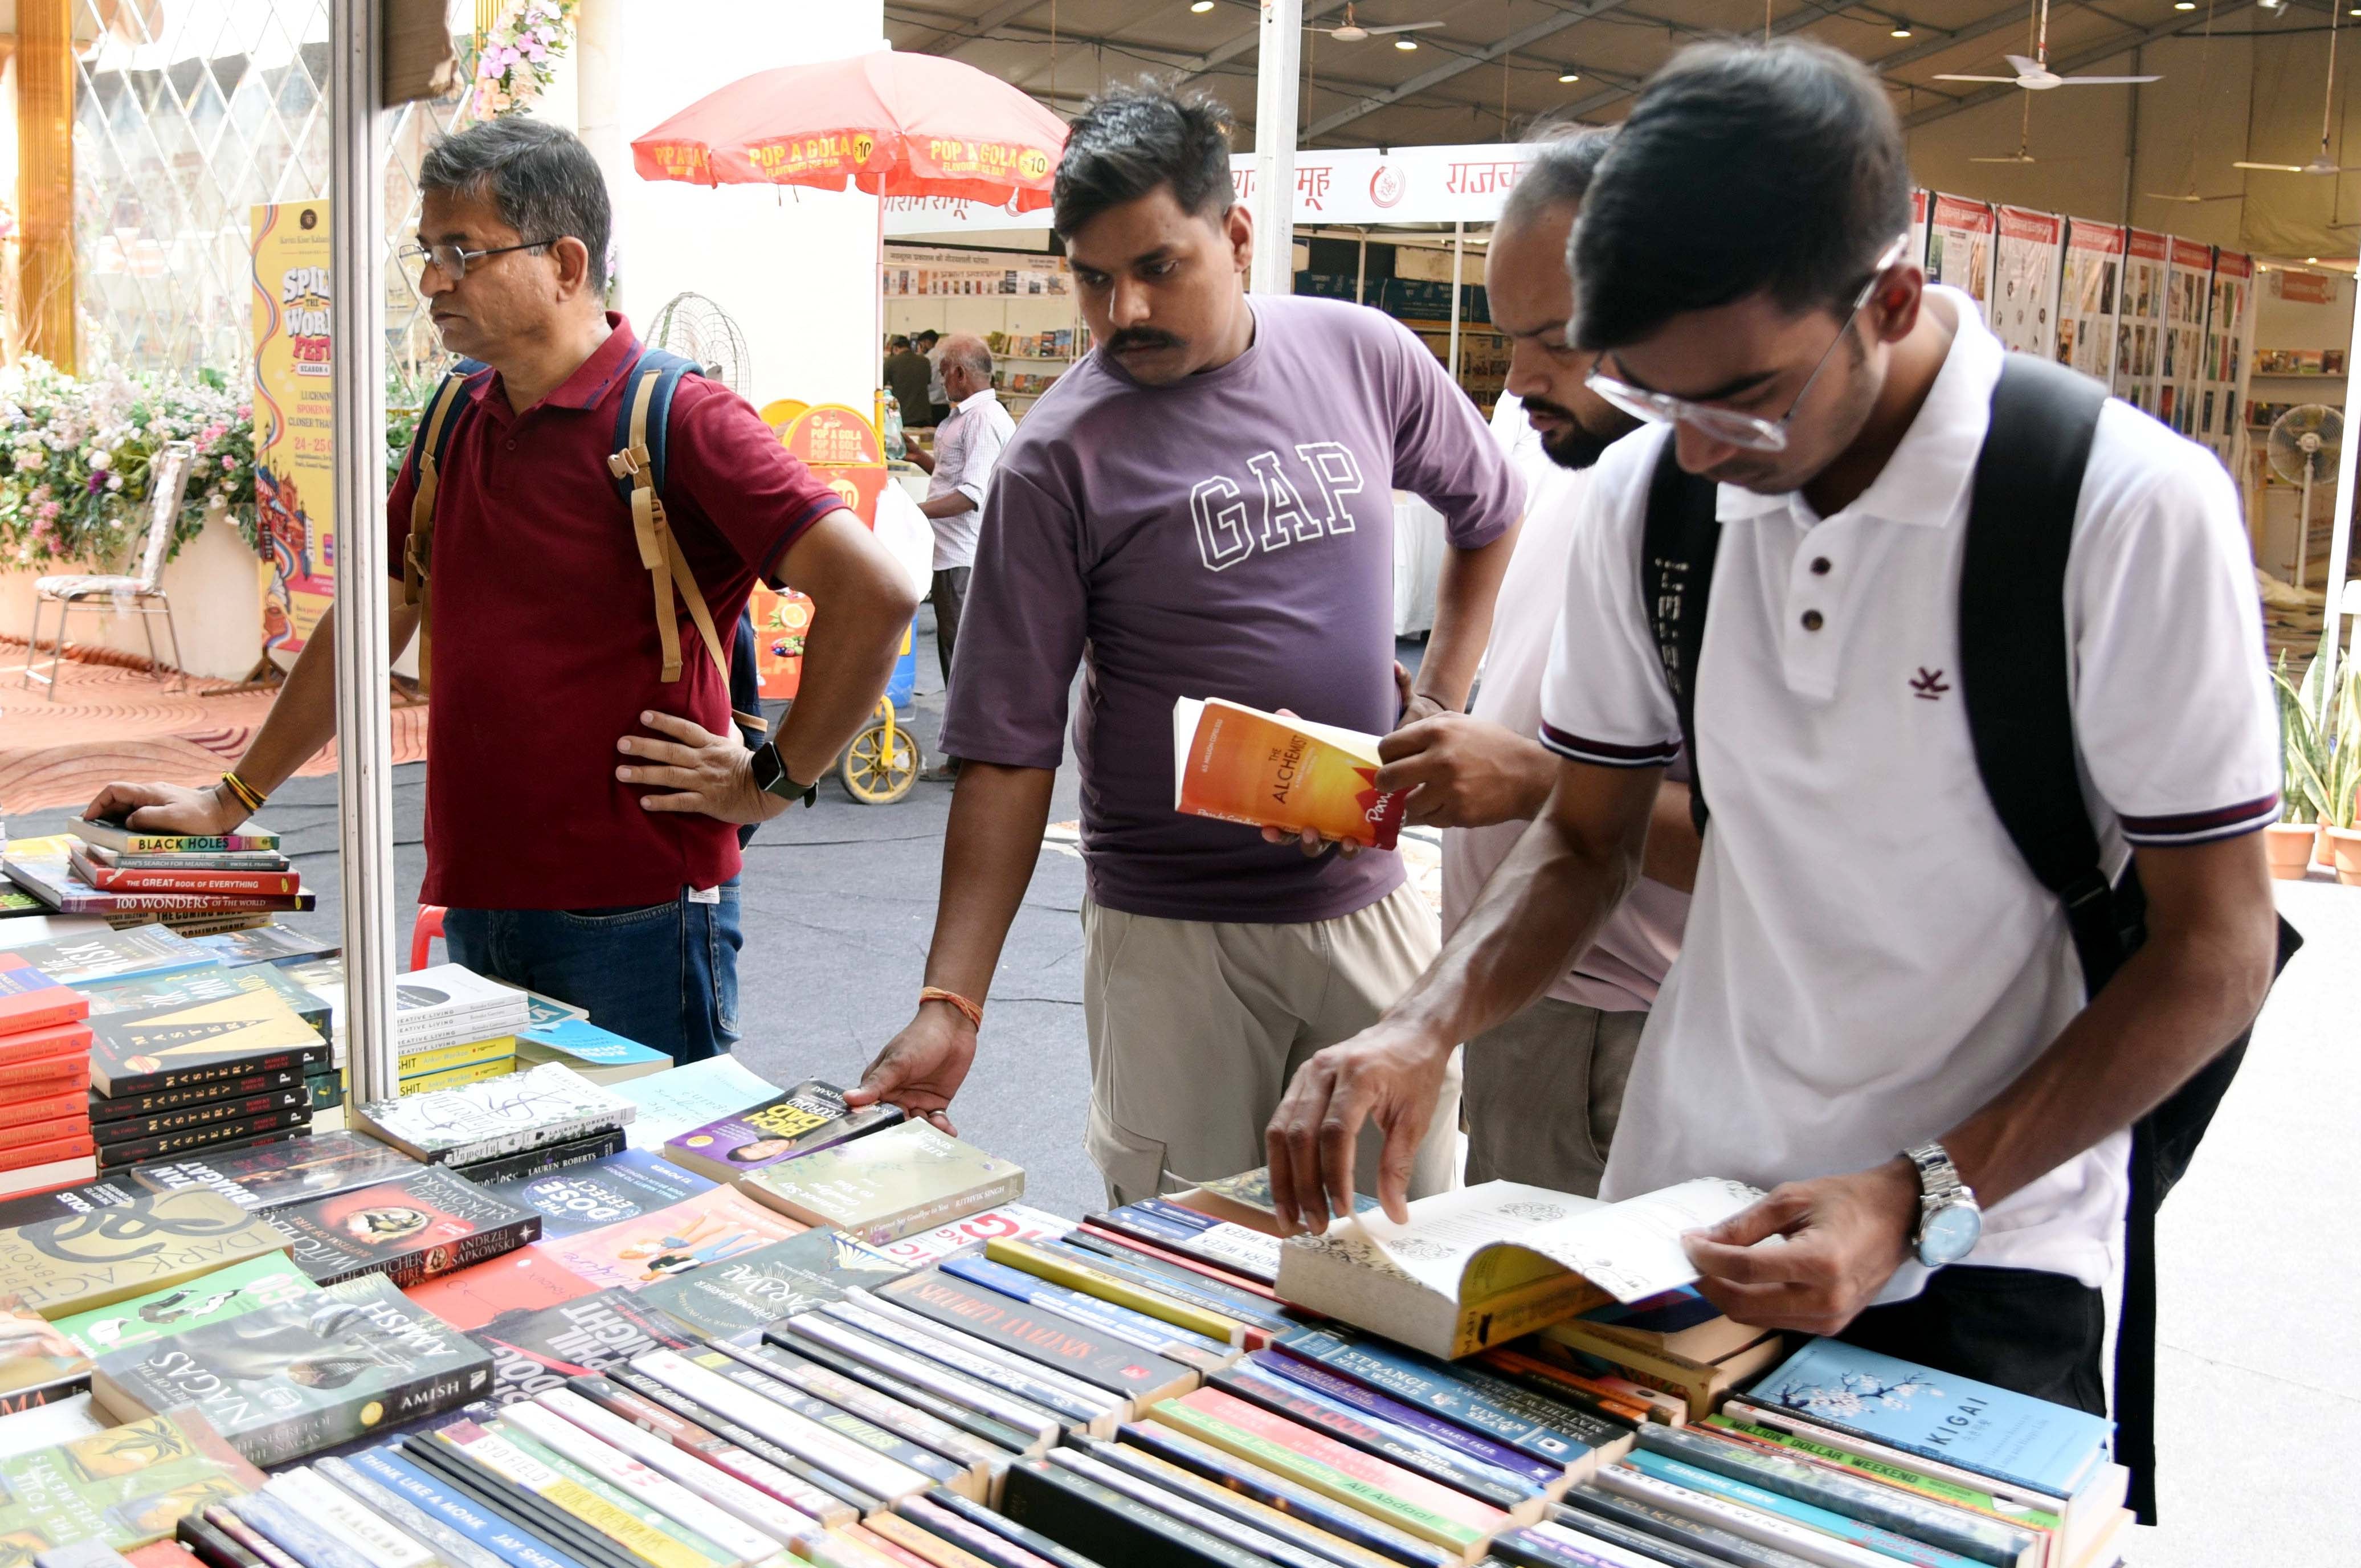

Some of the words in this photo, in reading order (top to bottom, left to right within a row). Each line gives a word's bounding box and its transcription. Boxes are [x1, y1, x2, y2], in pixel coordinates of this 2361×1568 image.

[749, 145, 785, 168] POP
[791, 142, 802, 162] A
[806, 136, 852, 160] GOLA
[930, 140, 962, 161] POP
[967, 142, 979, 162] A
[980, 144, 1017, 168] GOLA
[1295, 166, 1332, 211] मूह
[305, 298, 319, 307] THE
[288, 417, 313, 428] CLOSER
[296, 404, 324, 415] SPOKEN
[295, 436, 307, 450] 24
[811, 428, 828, 439] POP
[830, 429, 838, 439] A
[839, 429, 861, 440] GOLA
[811, 439, 828, 449] POP
[830, 439, 838, 450] A
[839, 439, 861, 451] GOLA
[1190, 441, 1364, 572] GAP
[1204, 738, 1215, 765] MILLION
[1268, 746, 1282, 762] THE
[1272, 734, 1310, 805] ALCHEMIST
[138, 838, 183, 850] BLACK
[187, 837, 229, 849] HOLES
[144, 859, 169, 868] SEARCH
[142, 877, 174, 888] GREAT
[175, 880, 196, 888] BOOK
[209, 880, 259, 889] EVERYTHING
[115, 897, 137, 910] 100
[141, 897, 209, 910] WONDERS
[156, 912, 174, 922] THE
[56, 941, 135, 974] RISK
[429, 1009, 455, 1018] LIVING
[430, 1019, 454, 1028] LIVING
[131, 1019, 257, 1046] MASTERY
[431, 1030, 455, 1040] LIVING
[431, 1040, 456, 1050] LIVING
[165, 1063, 255, 1088] MASTERY
[400, 1083, 421, 1097] SHIT
[142, 1085, 231, 1110] MASTERY
[149, 1106, 236, 1131] MASTERY
[549, 1122, 578, 1136] LAUREN
[581, 1114, 615, 1128] ROBERTS
[742, 1110, 800, 1139] RICH
[766, 1102, 832, 1130] DAD
[808, 1104, 844, 1121] POOR
[158, 1126, 244, 1152] MASTERY
[149, 1166, 185, 1190] TAN
[528, 1161, 559, 1177] LAUREN
[562, 1152, 597, 1167] ROBERTS
[650, 1162, 684, 1182] POWER
[175, 1162, 258, 1210] BHAGAT
[413, 1174, 507, 1220] SAPKOWSKI
[533, 1179, 612, 1220] DOSE
[569, 1179, 634, 1213] EFFECT
[405, 1186, 475, 1221] ANDRZEJ
[533, 1195, 567, 1218] THE
[875, 1220, 897, 1233] Cannot
[906, 1211, 931, 1225] Goodbye
[955, 1194, 983, 1208] RITHVIK
[983, 1186, 1006, 1198] SINGH
[264, 1211, 361, 1271] WITCHER
[459, 1230, 508, 1252] ANDRZEJ
[1200, 1234, 1235, 1256] WEEK
[1219, 1221, 1256, 1245] WEEK
[140, 1231, 269, 1274] DARK
[363, 1251, 424, 1277] WITCHER
[452, 1238, 514, 1266] SAPKOWSKI
[15, 1269, 115, 1305] AGE
[399, 1267, 420, 1281] FIRE
[361, 1299, 457, 1357] AMISH
[559, 1285, 664, 1372] NIGHT
[917, 1274, 1007, 1333] SECURITY
[998, 1305, 1098, 1371] ANALYSIS
[545, 1315, 626, 1385] PHIL
[492, 1345, 567, 1390] DOG
[1334, 1354, 1363, 1374] NEW
[1363, 1366, 1421, 1399] WORLD
[1344, 1346, 1434, 1396] STRANGE
[152, 1351, 257, 1426] NAGAS
[402, 1381, 460, 1410] AMISH
[1279, 1359, 1342, 1395] MILLIONAIRE
[1342, 1387, 1374, 1408] MIND
[627, 1373, 660, 1396] KEEP
[659, 1387, 699, 1412] GOING
[760, 1432, 796, 1461] KLEON
[761, 1375, 806, 1407] KWIK
[823, 1412, 902, 1449] LIMITLESS
[1231, 1370, 1286, 1406] BAD
[1287, 1391, 1382, 1447] BLOOD
[1464, 1407, 1515, 1437] SHAW
[1468, 1401, 1527, 1435] VIVIAN
[258, 1423, 309, 1447] SECRET
[312, 1415, 333, 1429] OF
[277, 1434, 321, 1453] NAGAS
[1437, 1426, 1467, 1444] HARV
[1468, 1438, 1497, 1457] EKER
[1169, 1399, 1255, 1448] Feel-Good
[1252, 1436, 1343, 1487] Productivity
[1342, 1477, 1372, 1498] Ali
[1370, 1487, 1436, 1525] Abdaal
[1382, 1438, 1465, 1484] Carreyrou
[1414, 1446, 1451, 1469] John
[1730, 1416, 1784, 1447] MILLION
[1788, 1433, 1844, 1465] DOLLAR
[1849, 1451, 1918, 1489] WEEKEND
[557, 1456, 589, 1483] Word
[590, 1476, 640, 1513] Power
[1483, 1479, 1522, 1503] PICADOR
[1664, 1458, 1739, 1497] JIMENEZ
[361, 1453, 399, 1480] THINK
[401, 1474, 428, 1498] LIKE
[441, 1500, 487, 1530] MONK
[492, 1531, 519, 1551] JAY
[476, 1438, 504, 1462] SYD
[508, 1452, 552, 1484] FIELD
[548, 1480, 584, 1510] FOUR
[582, 1491, 668, 1553] SCREENPLAYS
[1606, 1461, 1658, 1489] BEST
[1734, 1505, 1792, 1537] WINS
[1125, 1501, 1189, 1537] MIRACLES
[1612, 1491, 1707, 1538] TOLKIEN
[1188, 1530, 1237, 1558] MAKING
